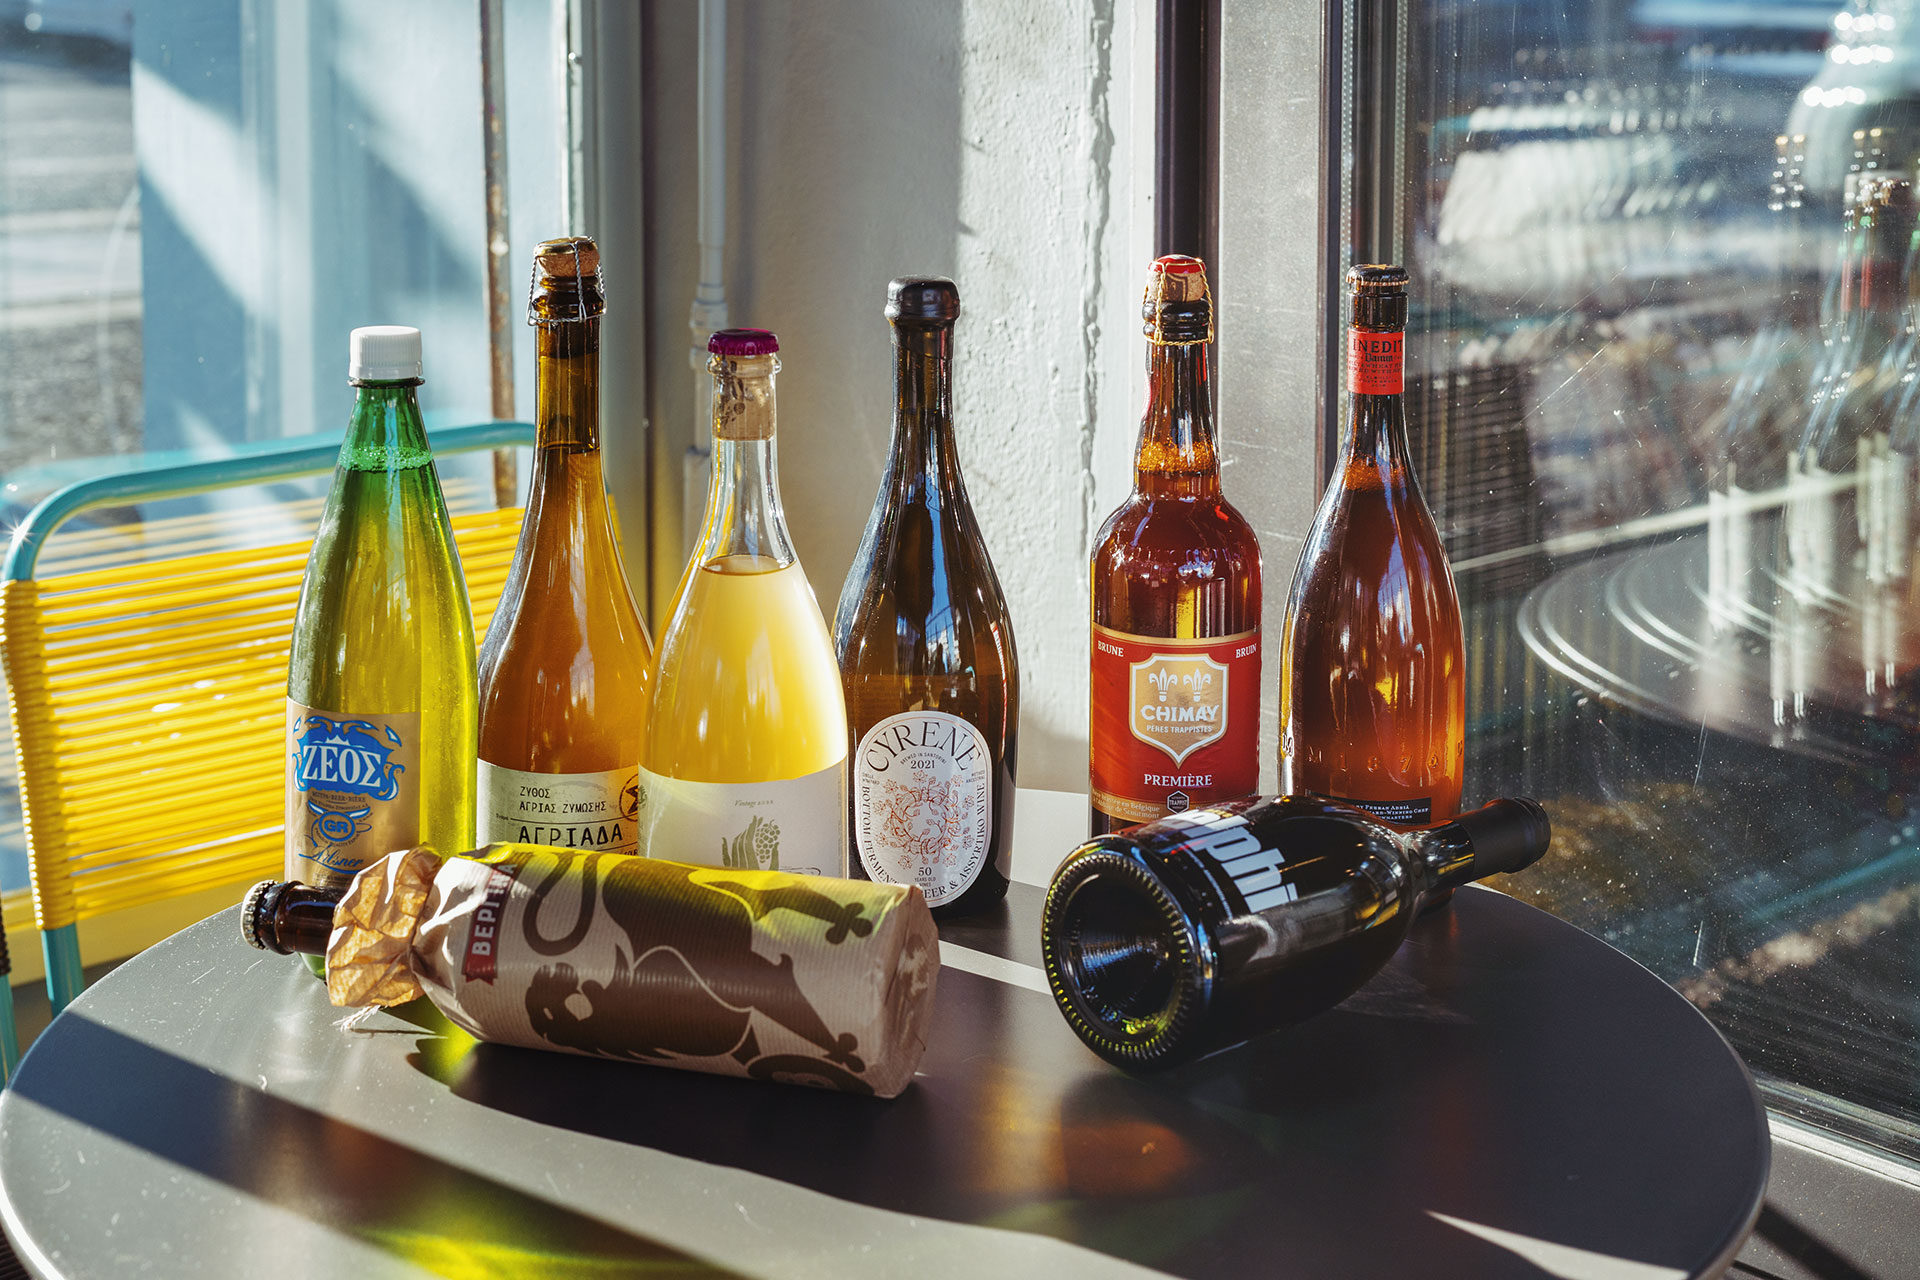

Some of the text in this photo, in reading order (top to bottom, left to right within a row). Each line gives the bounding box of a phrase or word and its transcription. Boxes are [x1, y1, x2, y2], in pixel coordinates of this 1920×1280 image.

[1365, 353, 1393, 362] Damm
[1098, 640, 1124, 658] BRUNE
[1235, 643, 1257, 659] BRUIN
[1140, 704, 1220, 723] CHIMAY
[1170, 725, 1213, 734] TRAPPISTES
[865, 721, 982, 772] CYRENE
[302, 744, 381, 788] ΖΕΟΣ
[910, 759, 935, 769] 2021
[1143, 773, 1213, 788] PREMIÈRE
[520, 786, 550, 799] ΖΥΘΟΣ
[519, 800, 607, 814] ΑΓΡΙΑΣ ΖΥΜΩΣΗΣ
[1123, 808, 1160, 819] Scourmont
[1130, 802, 1160, 813] Belgique
[324, 820, 349, 833] GR
[518, 823, 623, 847] ΑΓΡΙΑΔΑ
[861, 786, 901, 884] BOTTOM FERMEN
[924, 782, 986, 899] EER & ASSYRTIKO WINE
[311, 843, 364, 868] Pilsner
[918, 866, 932, 877] 50
